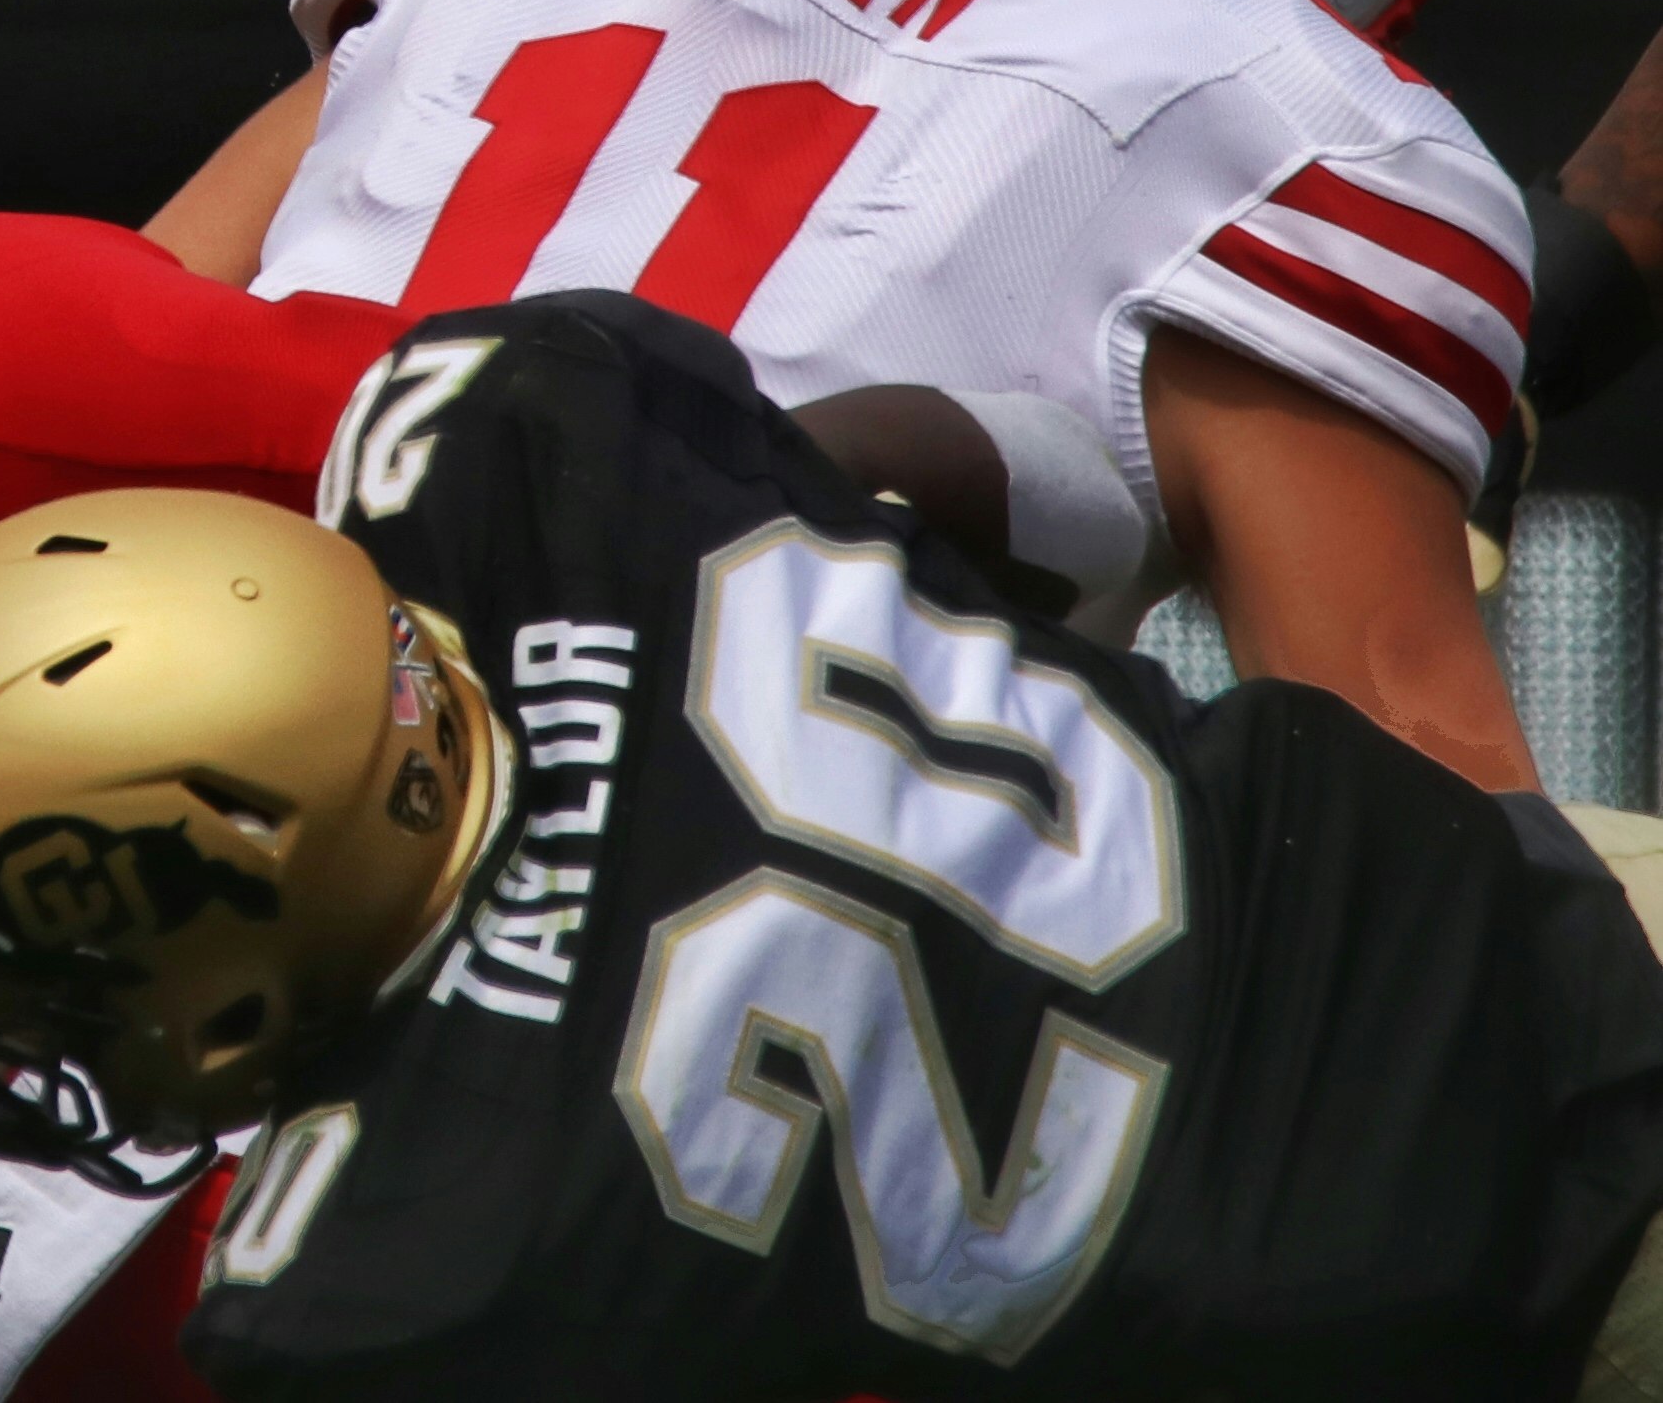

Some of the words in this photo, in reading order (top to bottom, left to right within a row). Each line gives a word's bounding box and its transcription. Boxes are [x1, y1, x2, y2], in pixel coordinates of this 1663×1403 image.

[400, 24, 878, 337] 11
[430, 619, 638, 1024] TAYLOR
[613, 516, 1187, 1367] 20
